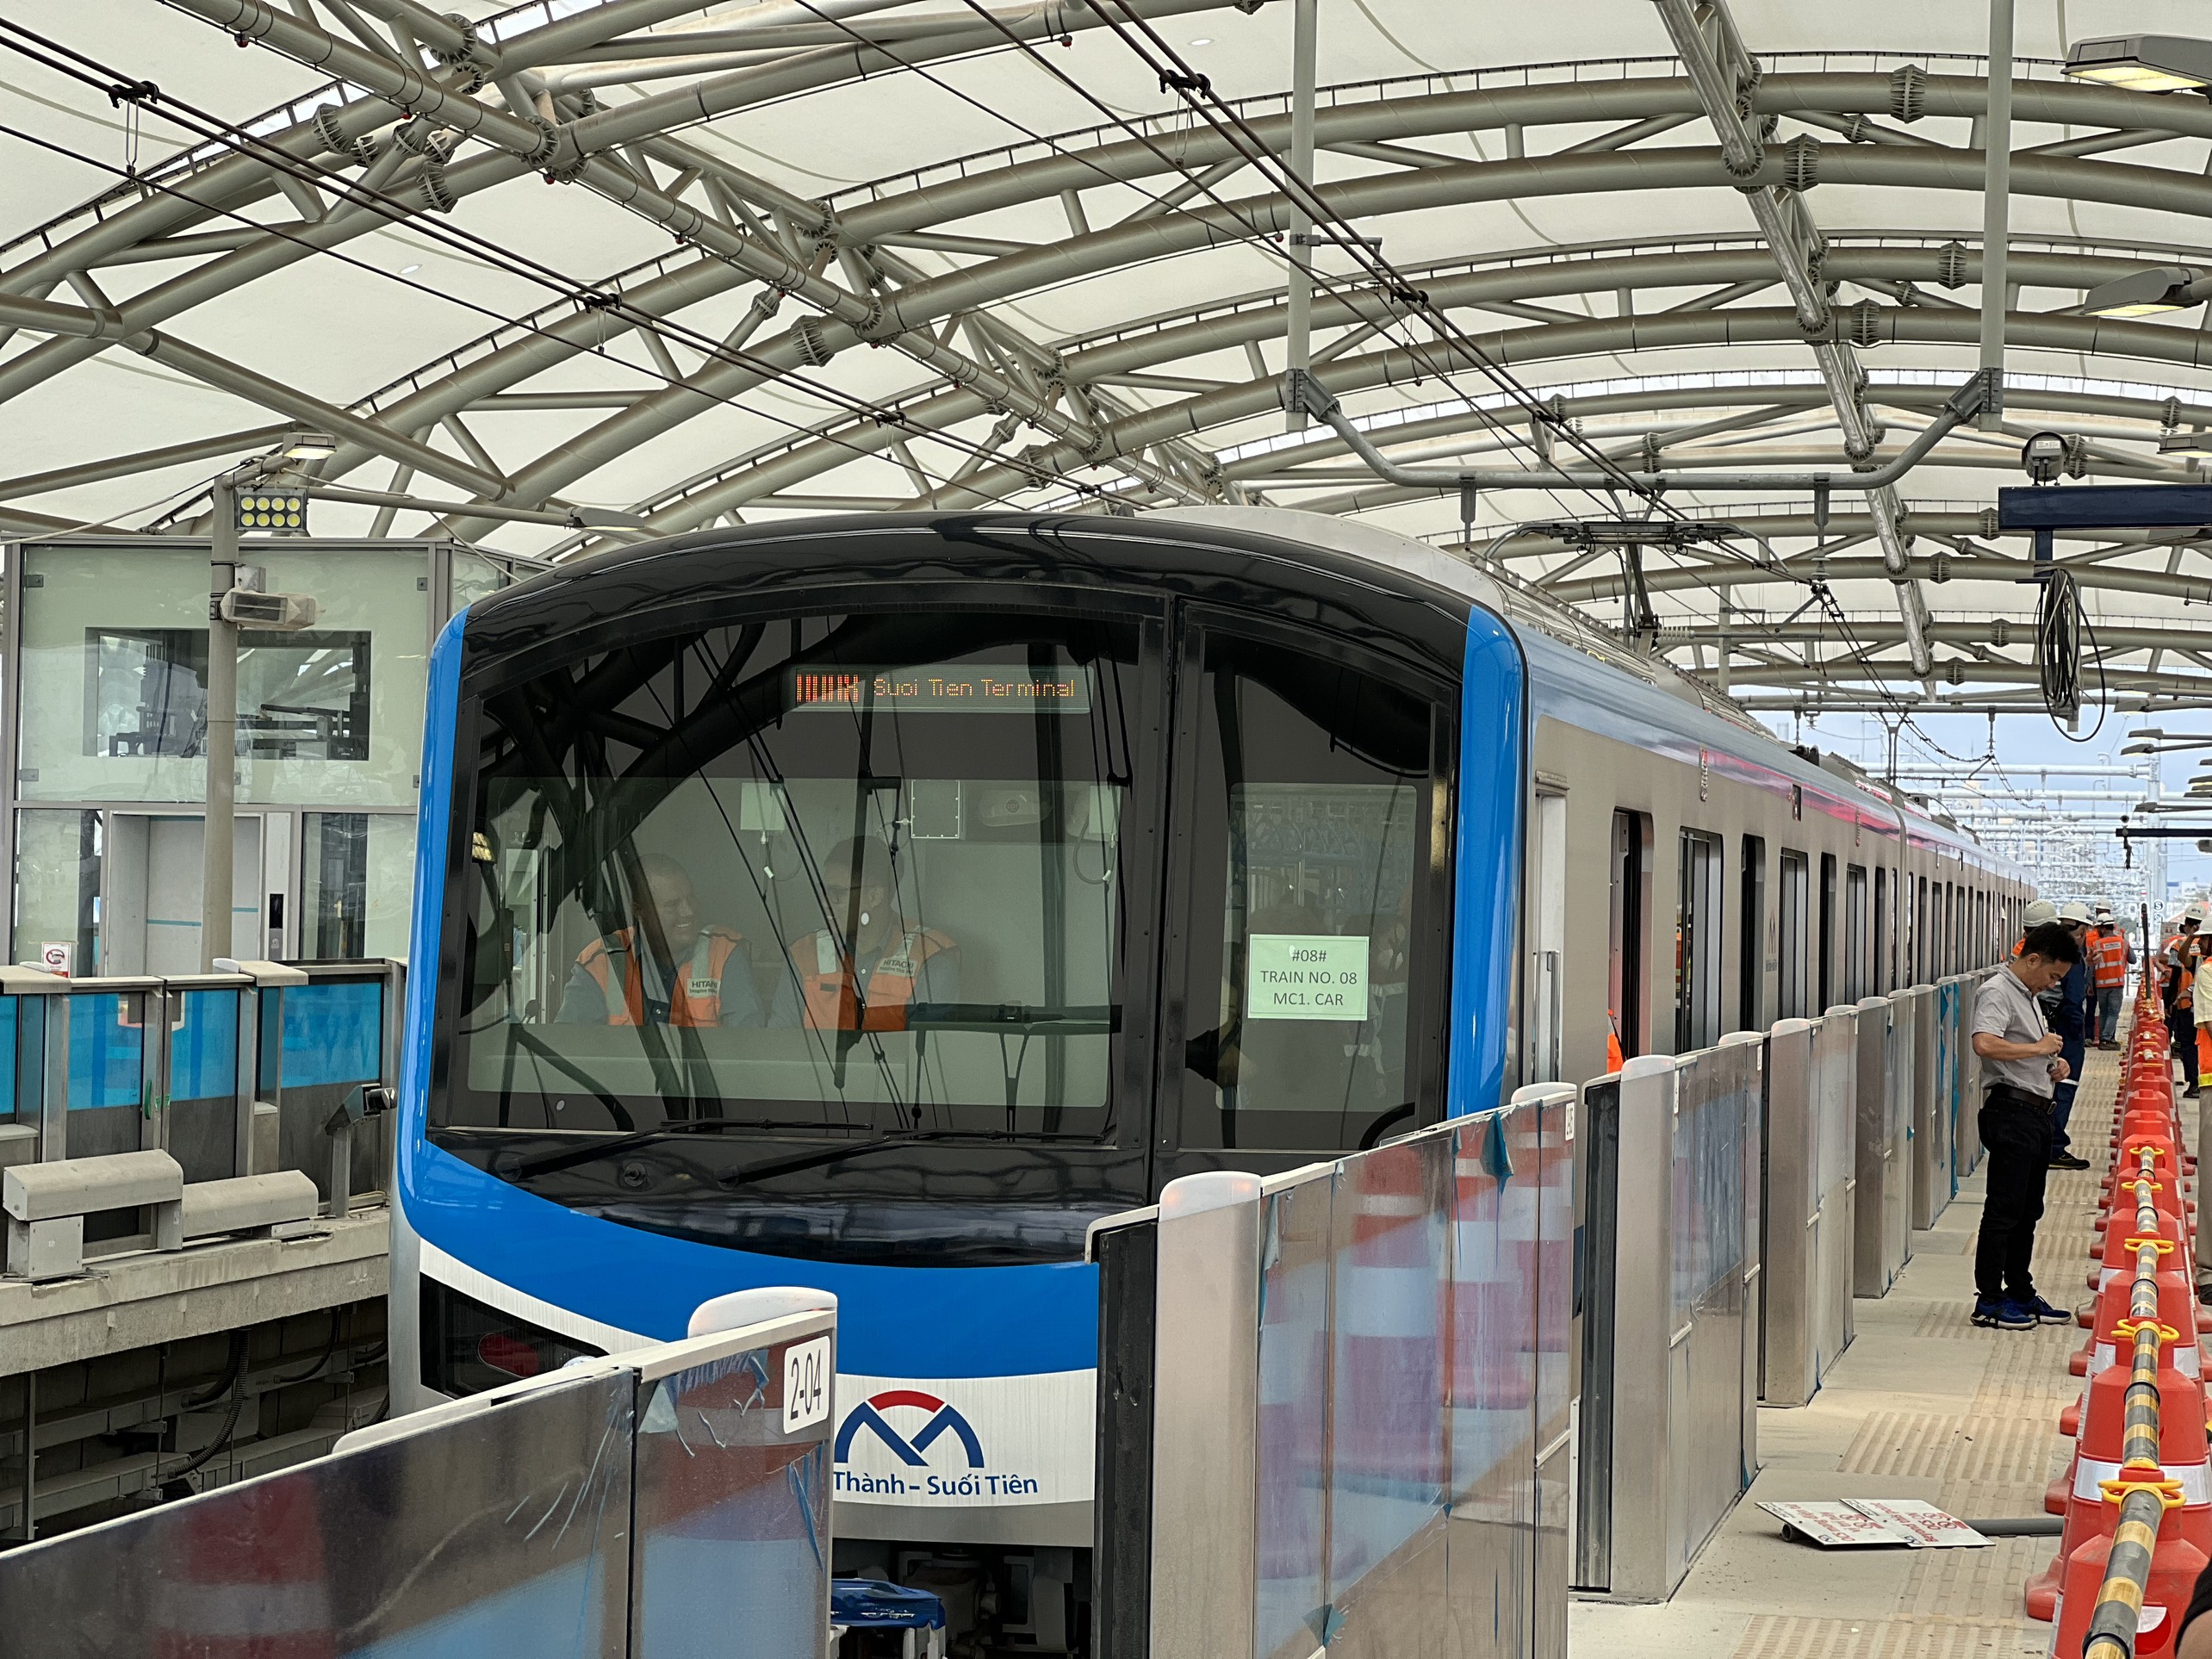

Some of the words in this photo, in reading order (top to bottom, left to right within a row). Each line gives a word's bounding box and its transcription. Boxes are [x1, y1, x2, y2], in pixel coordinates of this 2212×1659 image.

[873, 678, 918, 697] Suoi
[928, 678, 973, 697] Tien
[981, 678, 1075, 697] Terminal
[1291, 949, 1327, 962] #08#
[1259, 970, 1303, 984] TRAIN
[1308, 971, 1335, 985] NO.
[1339, 972, 1358, 985] 08
[1273, 992, 1310, 1005] MC1.
[1314, 993, 1344, 1006] CAR
[790, 1348, 822, 1421] 2-04
[833, 1470, 904, 1494] Thành
[927, 1473, 980, 1496] Suối
[985, 1474, 1039, 1495] Tiên
